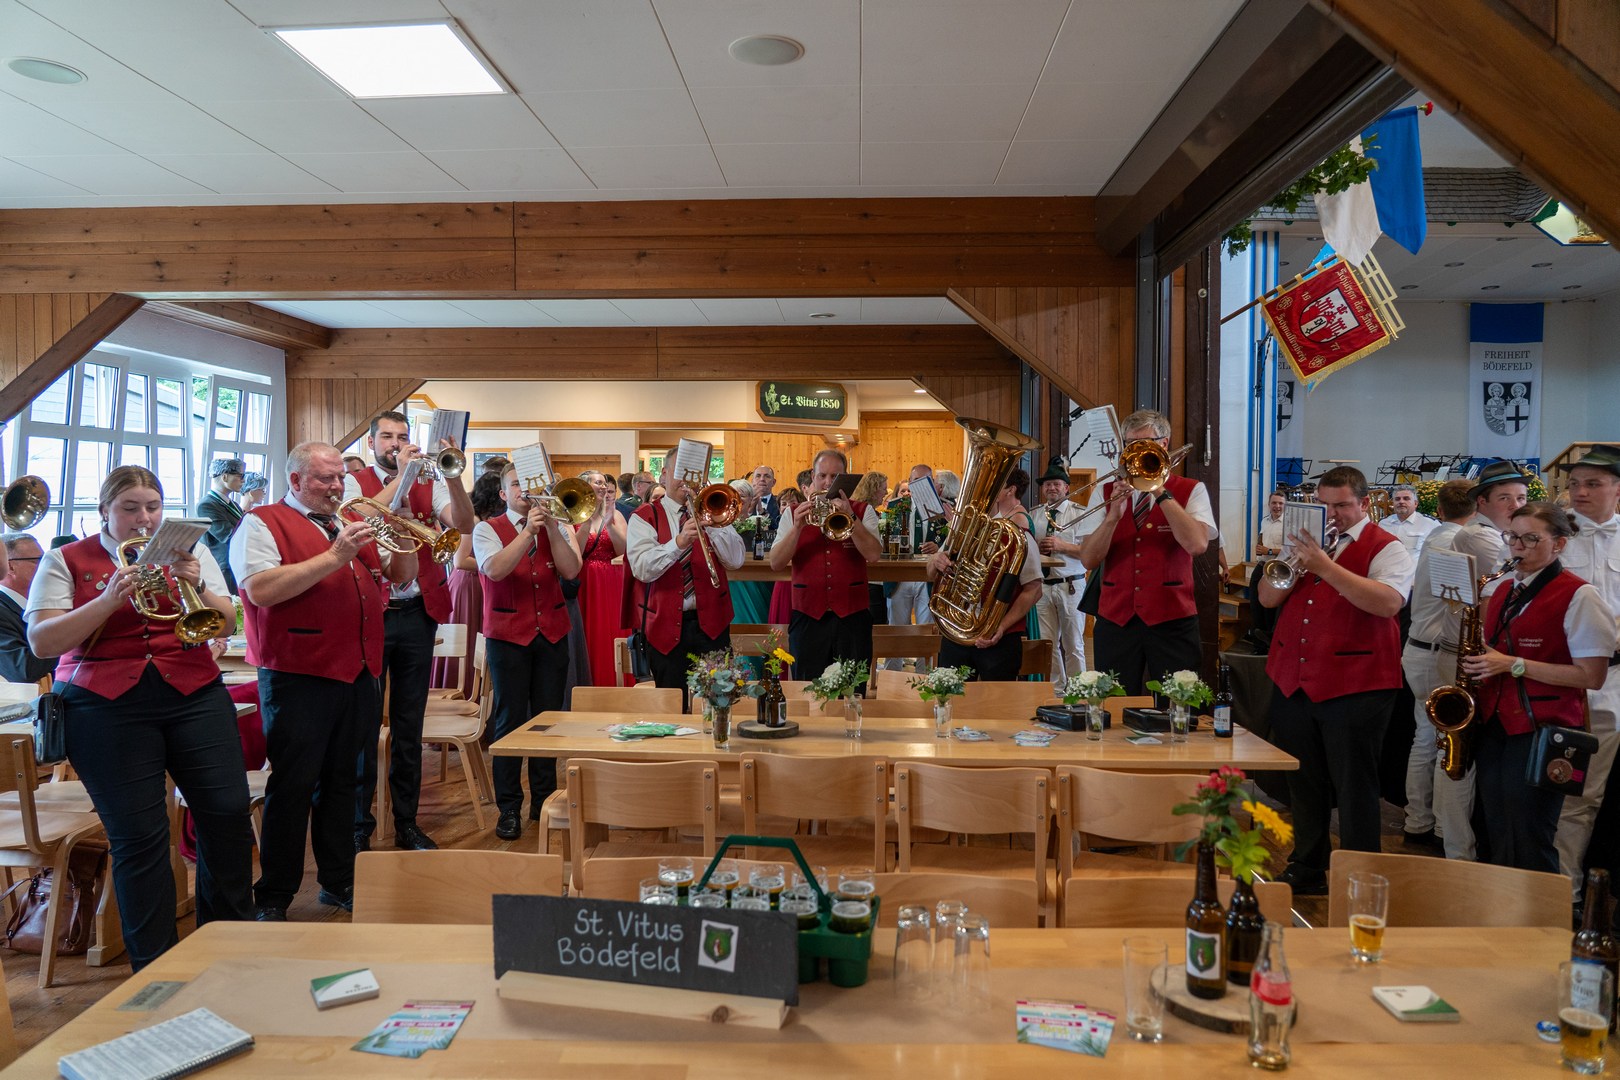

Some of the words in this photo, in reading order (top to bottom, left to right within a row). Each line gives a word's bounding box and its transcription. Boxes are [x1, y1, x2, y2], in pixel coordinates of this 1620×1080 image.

[1336, 268, 1356, 300] Schützen
[1353, 300, 1365, 313] der
[1361, 312, 1379, 334] Stadt
[1483, 361, 1532, 370] BÖDEFELD
[1484, 351, 1530, 359] FREIHEIT
[780, 394, 794, 406] St.
[795, 395, 819, 408] Vitus
[820, 398, 840, 410] 1850
[574, 908, 613, 936] St.
[618, 911, 685, 943] Vitus
[558, 937, 682, 976] Bödefeld
